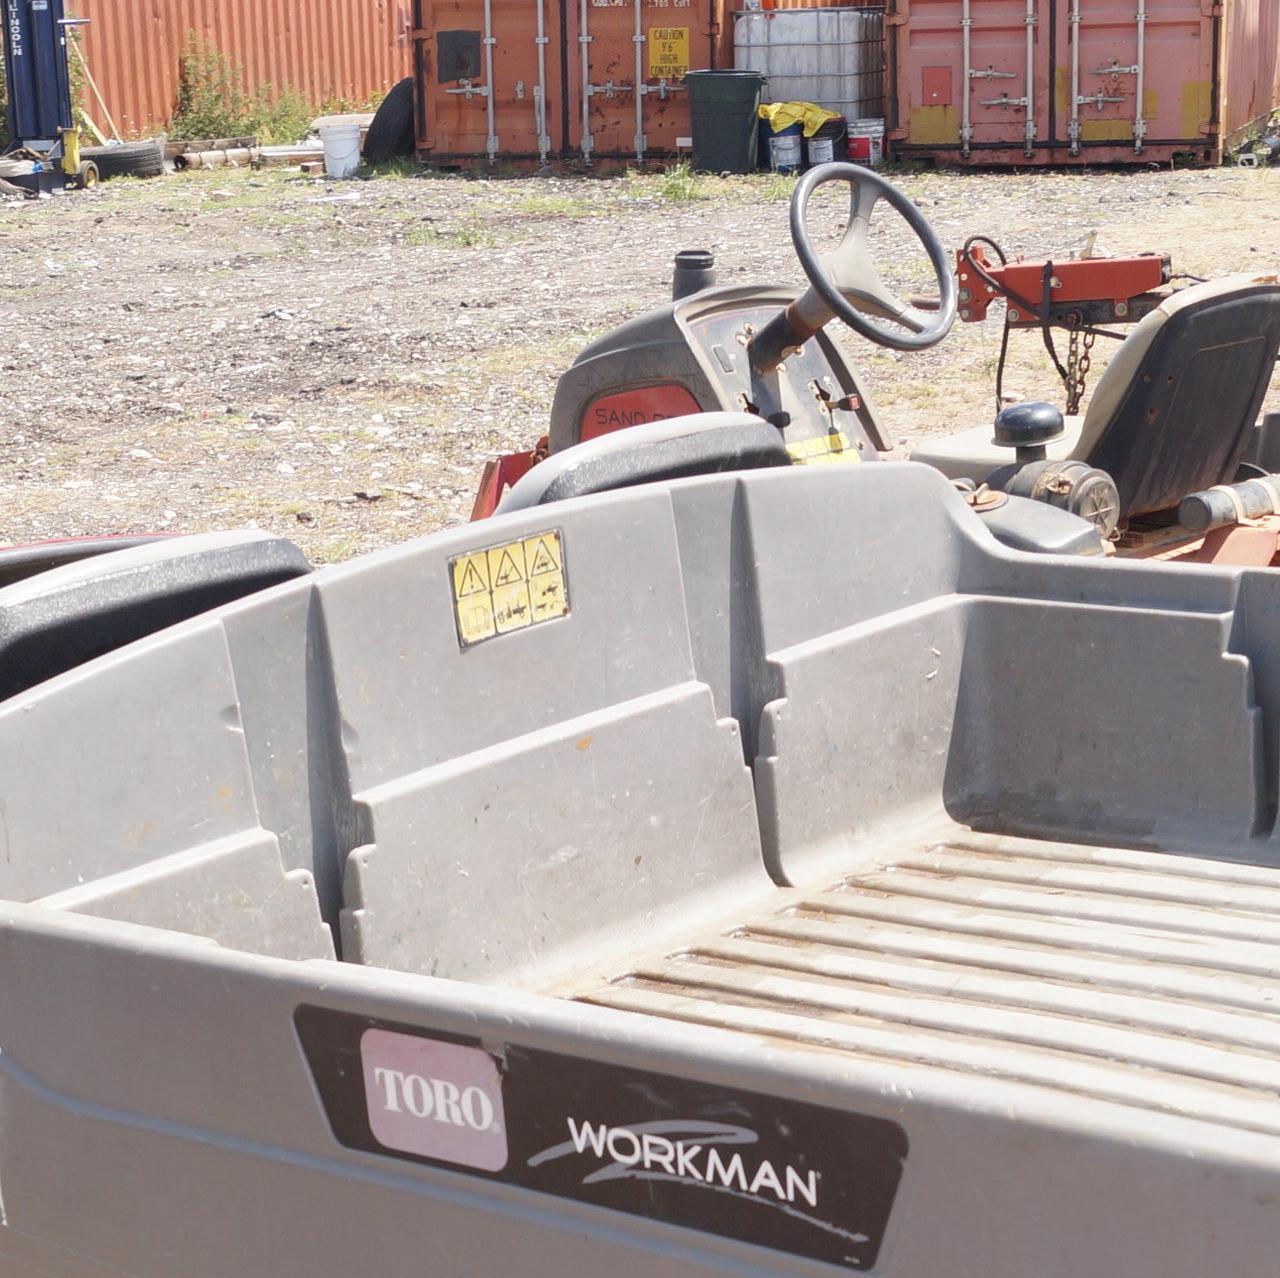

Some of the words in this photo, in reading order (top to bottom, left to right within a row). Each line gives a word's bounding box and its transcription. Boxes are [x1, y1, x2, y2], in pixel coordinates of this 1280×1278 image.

[8, 4, 23, 56] LINCOLN
[653, 29, 684, 41] CAUTION
[595, 408, 645, 426] SAND
[374, 1067, 495, 1132] TORO
[566, 1116, 819, 1208] WORKMAN
